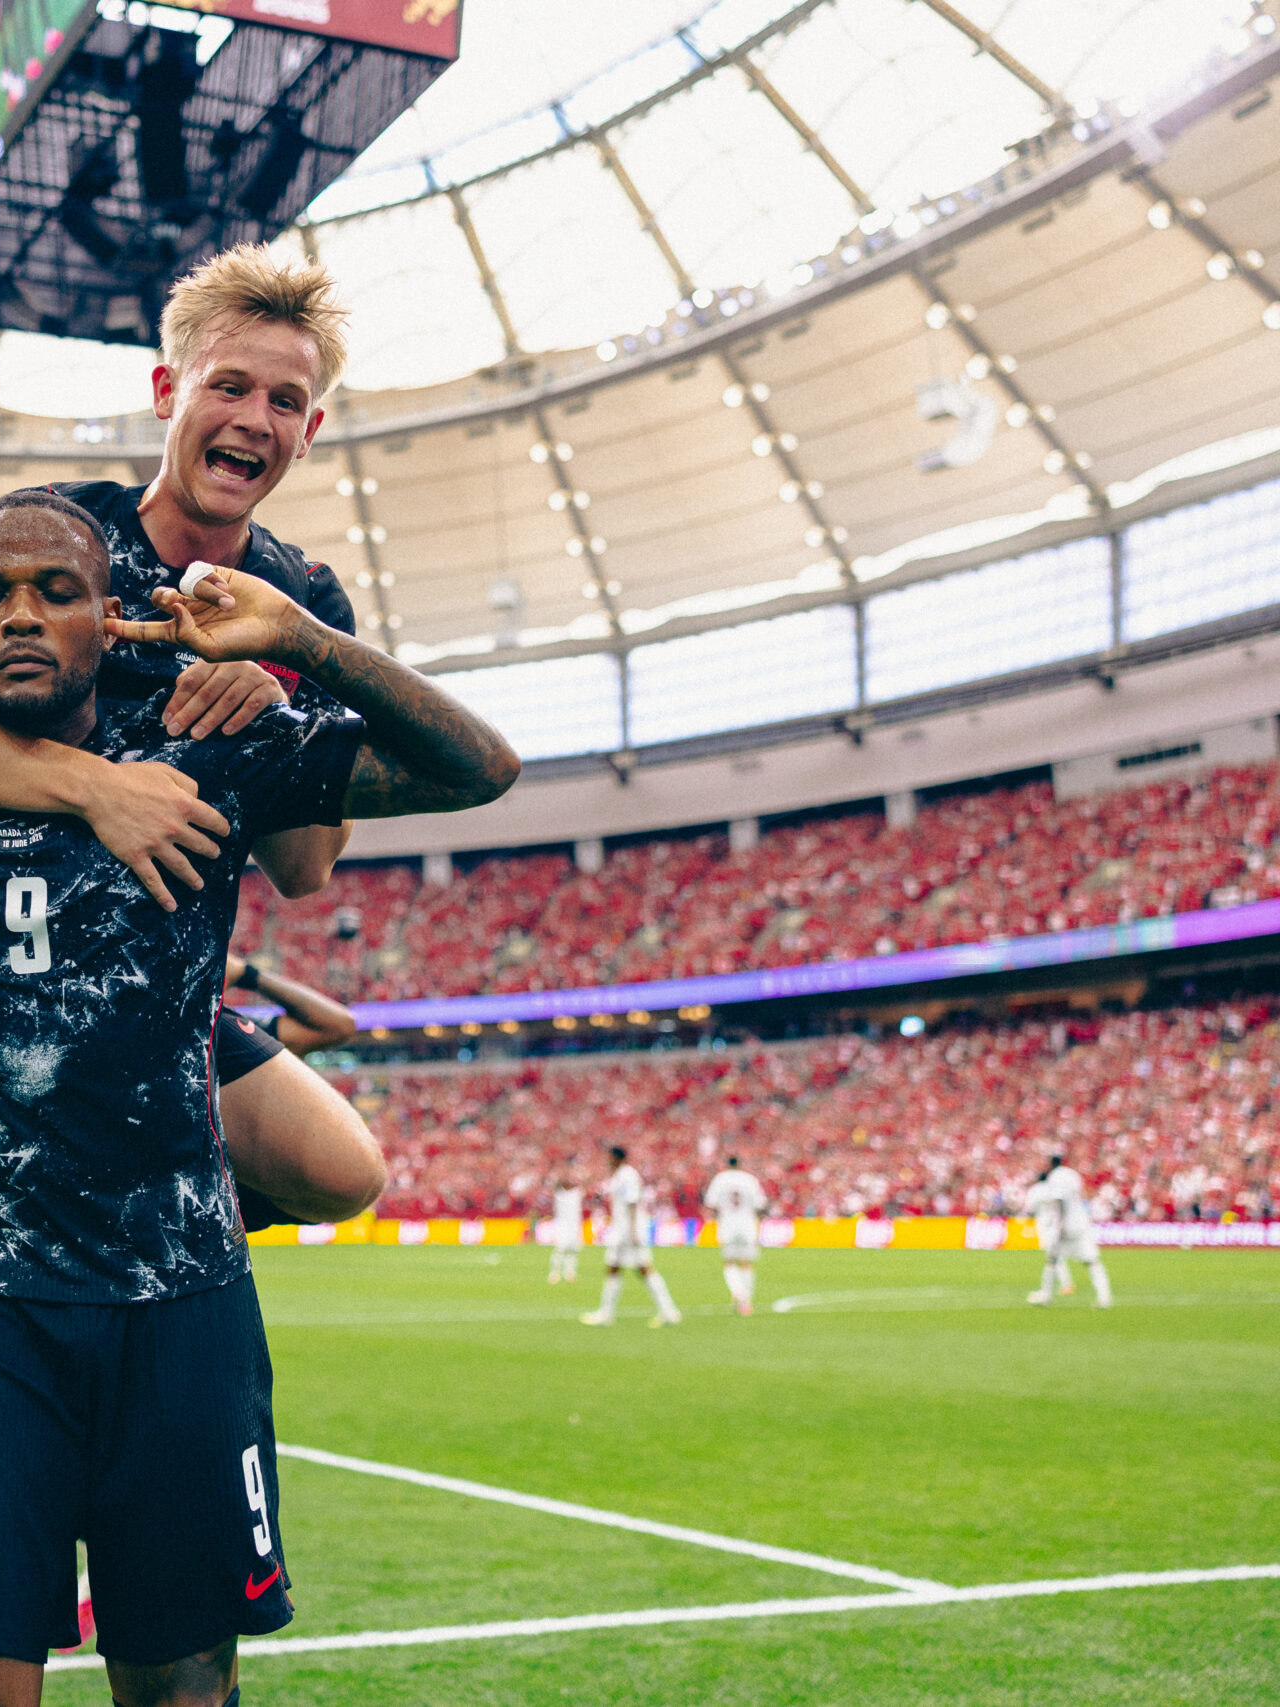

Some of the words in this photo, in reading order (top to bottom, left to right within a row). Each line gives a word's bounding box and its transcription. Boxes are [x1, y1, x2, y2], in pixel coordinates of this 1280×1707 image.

[260, 663, 300, 681] CANADA
[2, 840, 10, 848] 18
[11, 839, 28, 848] JUNE
[5, 876, 51, 974] 9
[241, 1444, 272, 1557] 9
